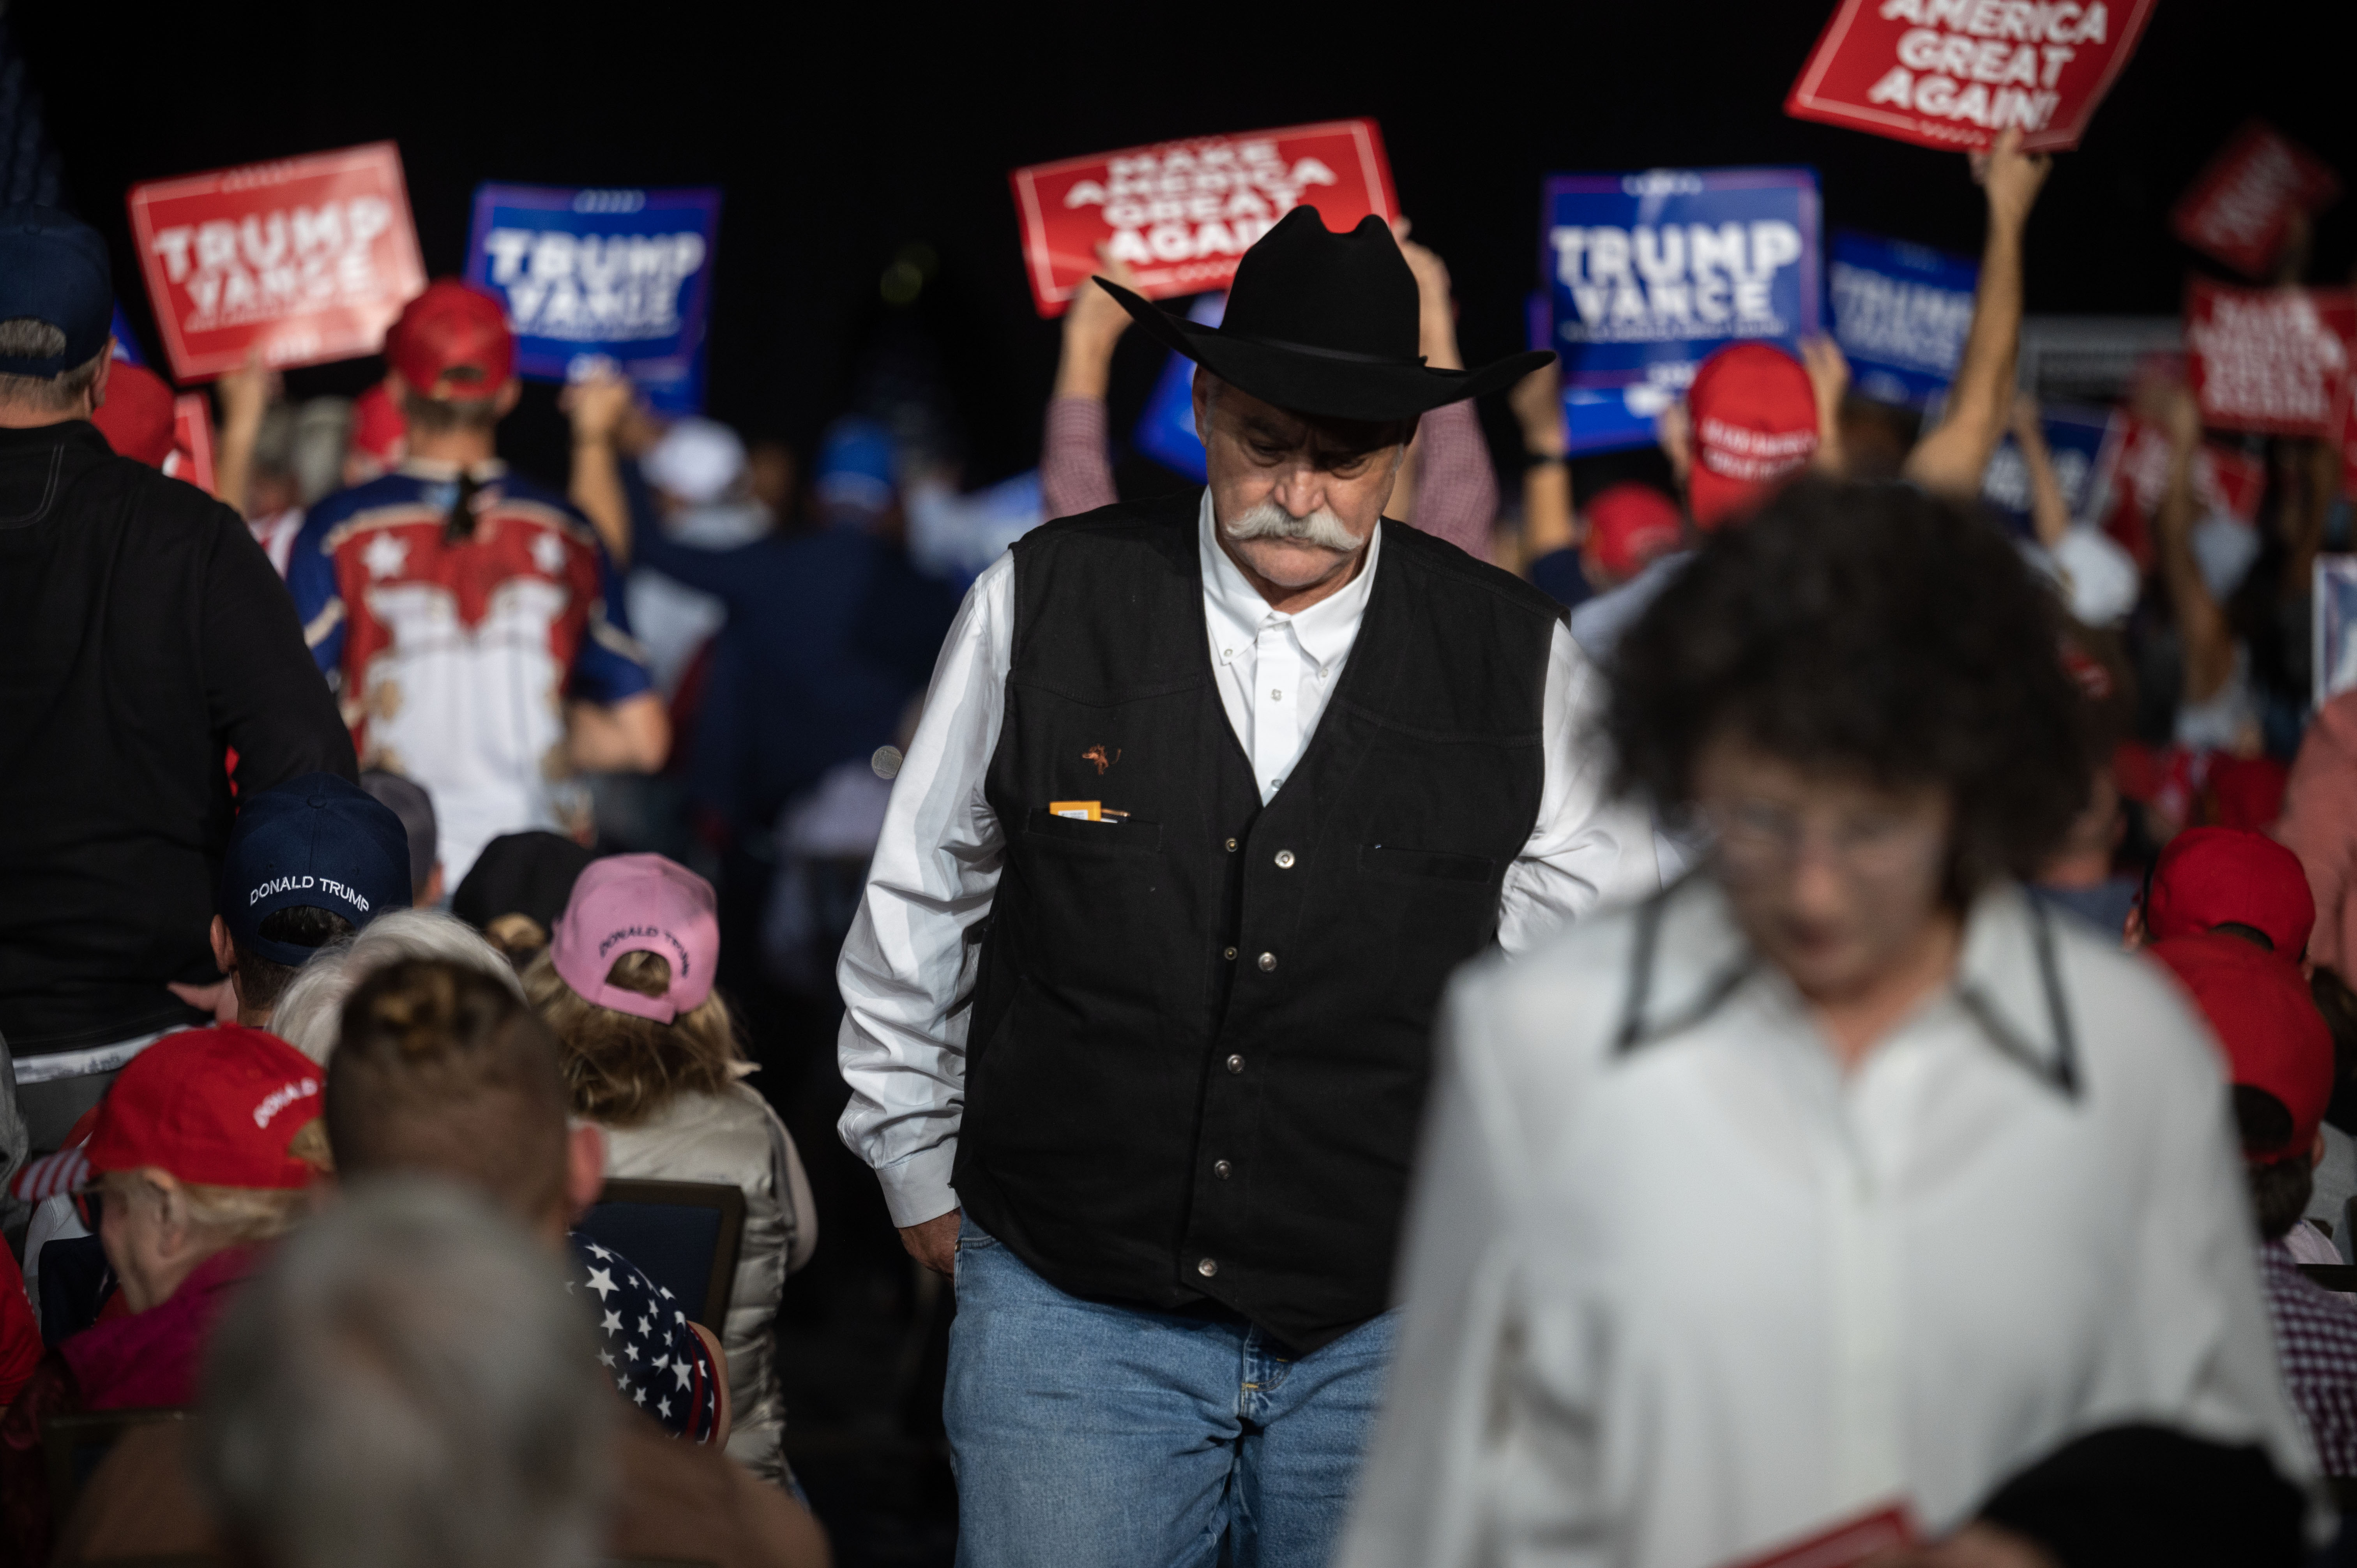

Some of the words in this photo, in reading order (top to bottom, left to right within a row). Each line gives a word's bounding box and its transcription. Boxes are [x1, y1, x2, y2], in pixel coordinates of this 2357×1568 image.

[1878, 0, 2108, 44] AMERICA
[1896, 26, 2076, 89] GREAT
[1867, 64, 2062, 132] AGAIN!
[1063, 158, 1338, 209] AMERICA
[1102, 186, 1304, 229] GREAT
[153, 195, 392, 284] TRUMP
[484, 226, 706, 286] TRUMP
[1550, 219, 1802, 287] TRUMP
[186, 245, 369, 316] VANCE
[506, 280, 679, 325] VANCE
[1569, 279, 1775, 327] VANCE
[250, 876, 314, 907] DONALD
[319, 878, 369, 912] TRUMP
[599, 925, 659, 960] DONALD
[253, 1076, 318, 1129] DONALD
